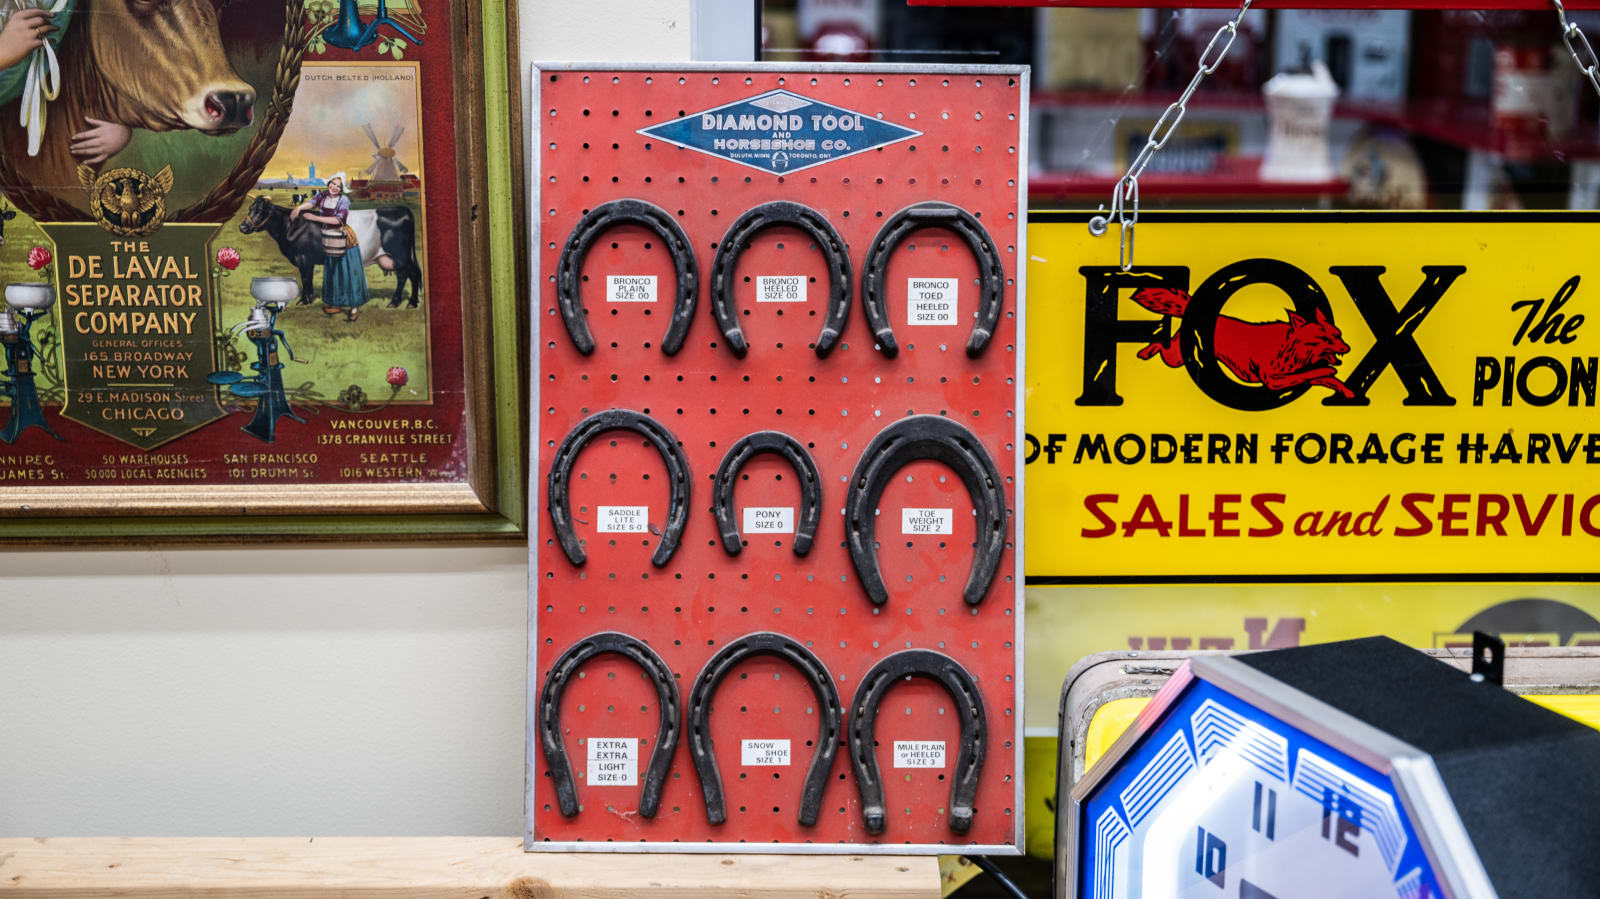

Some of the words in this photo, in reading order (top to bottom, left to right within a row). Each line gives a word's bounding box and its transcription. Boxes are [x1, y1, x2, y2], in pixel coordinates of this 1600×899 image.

[702, 114, 803, 131] DIAMOND
[811, 114, 864, 131] TOOL
[712, 139, 816, 150] HORSESHOE
[822, 140, 850, 150] CO.
[111, 241, 150, 252] THE
[69, 256, 103, 278] DE
[113, 256, 198, 278] LAVAL
[66, 285, 202, 306] SEPARATOR
[1511, 275, 1585, 346] The
[75, 312, 196, 334] COMPANY
[1074, 257, 1467, 411] FOX
[85, 352, 108, 361] 165
[114, 352, 192, 361] BROADWAY
[93, 365, 130, 378] NEW
[137, 365, 188, 378] YORK
[1473, 356, 1598, 407] PION
[78, 393, 92, 403] 29
[103, 408, 184, 420] CHICAGO
[318, 435, 342, 444] 1378
[346, 435, 405, 444] GRANVILLE
[411, 434, 451, 443] STREET
[1073, 433, 1258, 465] MODERN
[1271, 433, 1444, 464] FORAGE
[103, 455, 114, 464] 50
[119, 455, 188, 464] WAREHOUSES
[224, 454, 247, 463] SAN
[253, 454, 317, 463] FRANCISCO
[361, 454, 426, 463] SEATTLE
[121, 469, 152, 479] LOCAL
[157, 469, 206, 478] AGENCIES
[229, 469, 244, 477] 101
[251, 468, 297, 478] DRUMM
[340, 468, 361, 477] 1016
[365, 468, 423, 478] WESTERN
[1081, 493, 1286, 538] SALES
[1294, 494, 1390, 537] and
[897, 743, 919, 751] MULE
[1252, 780, 1277, 842] 11
[1323, 786, 1363, 858] 12
[1195, 825, 1227, 890] 10
